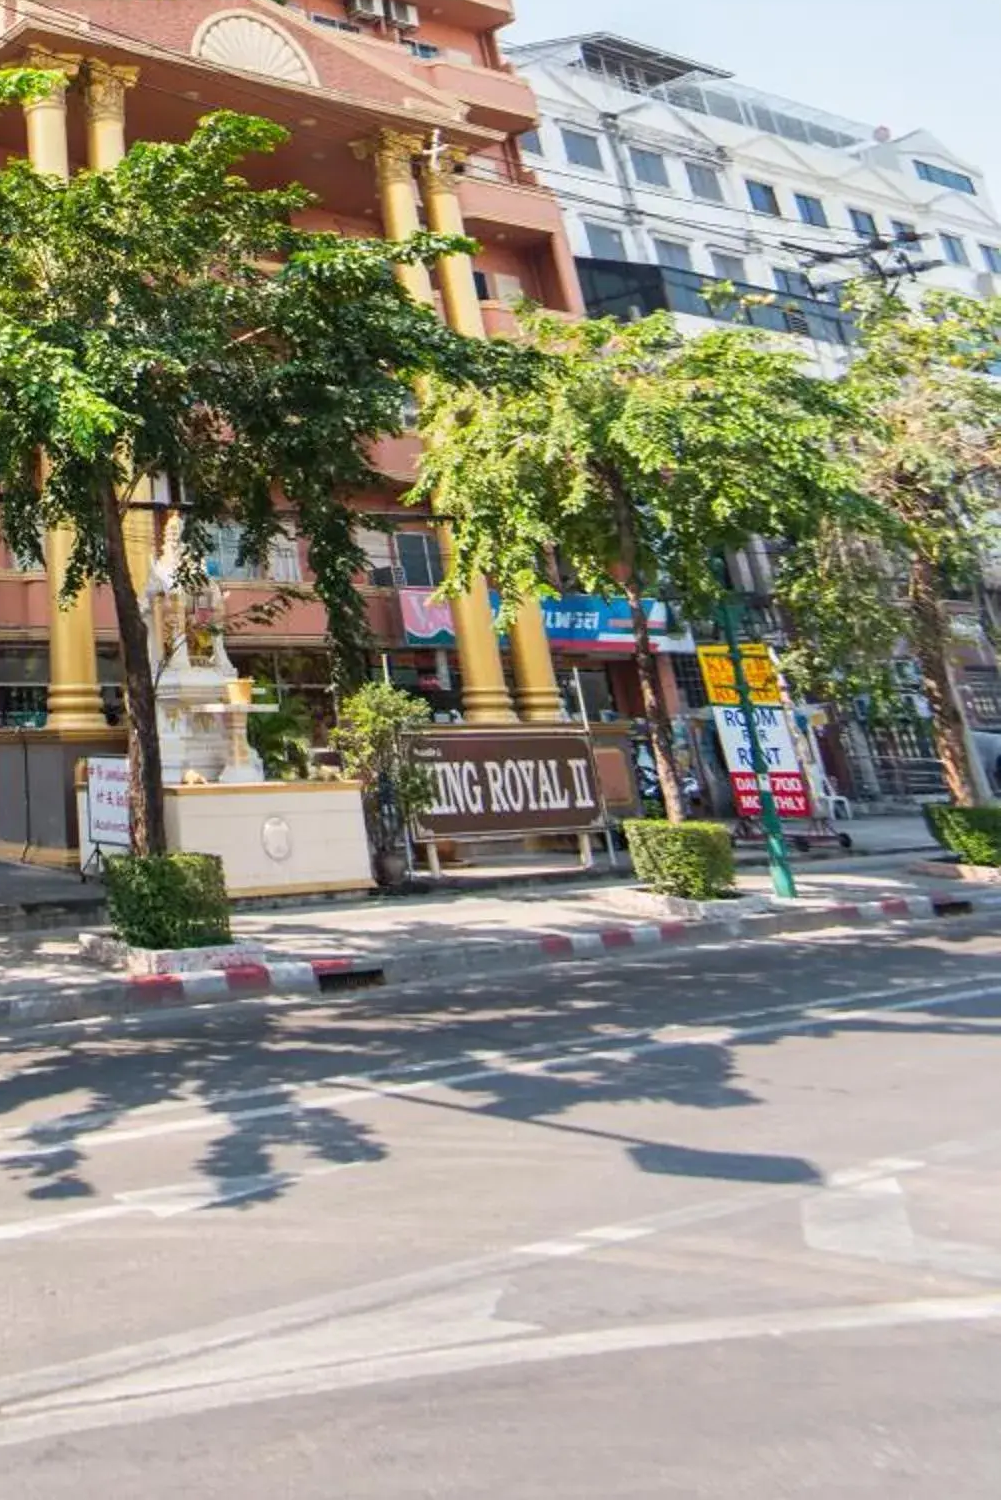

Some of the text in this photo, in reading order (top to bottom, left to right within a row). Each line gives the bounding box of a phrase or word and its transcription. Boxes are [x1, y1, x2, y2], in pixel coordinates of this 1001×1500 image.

[743, 729, 769, 742] FR
[737, 747, 781, 766] RNT
[414, 758, 595, 815] ING ROYAL II
[740, 795, 806, 811] MOTHLY
